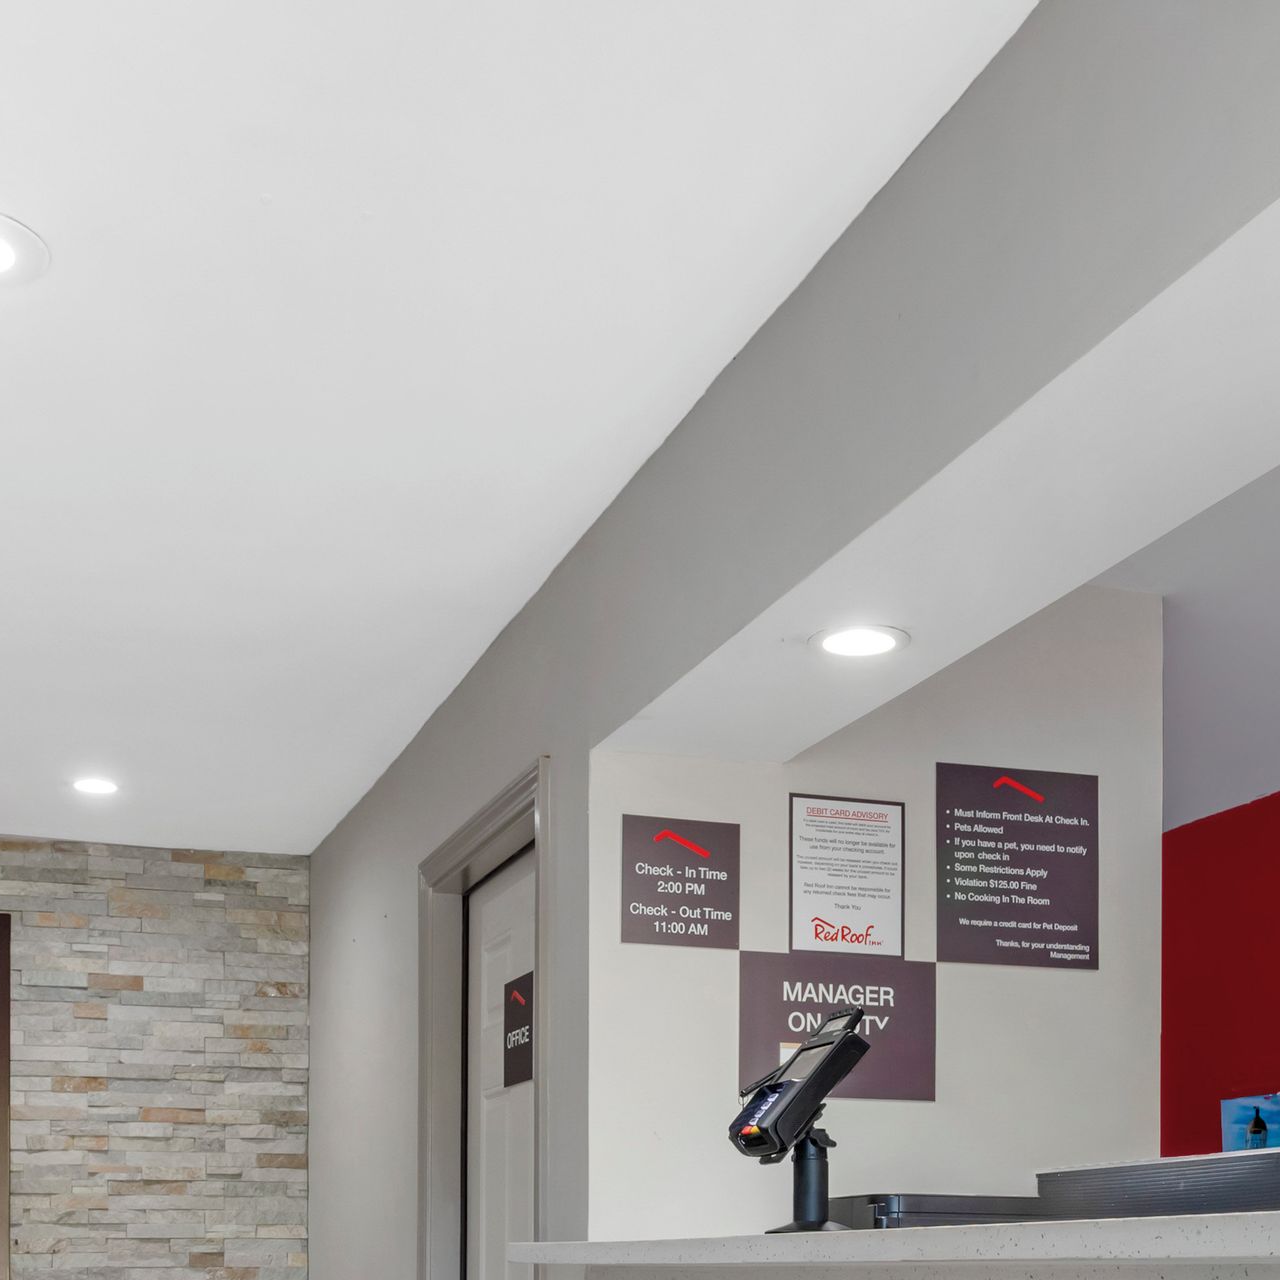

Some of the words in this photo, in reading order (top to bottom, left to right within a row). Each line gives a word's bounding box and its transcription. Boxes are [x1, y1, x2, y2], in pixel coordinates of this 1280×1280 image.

[806, 806, 828, 815] DEBIT
[829, 808, 851, 817] CARD
[851, 810, 889, 820] ADVISORY
[954, 808, 974, 818] Must
[976, 810, 1001, 820] Inform
[1002, 811, 1022, 821] Front
[1024, 813, 1043, 823] Desk
[1044, 815, 1053, 824] At
[1054, 815, 1079, 826] Check
[1080, 818, 1090, 826] In.
[954, 822, 972, 832] Pets
[972, 824, 1004, 834] Allowed
[954, 837, 960, 846] If
[961, 839, 976, 848] you
[977, 839, 996, 848] have
[997, 841, 1003, 849] a
[1004, 841, 1019, 851] pet,
[1020, 843, 1035, 852] you
[1036, 843, 1056, 853] need
[1056, 844, 1065, 853] to
[1066, 845, 1087, 856] notify
[954, 851, 975, 860] upon
[977, 851, 1001, 860] check
[1002, 852, 1010, 861] in
[635, 862, 674, 876] Check
[685, 866, 697, 878] In
[698, 867, 728, 880] Time
[954, 862, 978, 872] Some
[979, 865, 1024, 875] Restrictions
[1025, 868, 1048, 879] Apply
[657, 881, 682, 894] 2:00
[685, 883, 706, 895] PM
[954, 877, 988, 888] Violation
[989, 879, 1019, 890] $125.00
[1020, 882, 1037, 891] Fine
[954, 891, 966, 900] No
[967, 892, 1001, 904] Cooking
[1002, 895, 1010, 903] In
[1011, 895, 1025, 904] The
[1026, 896, 1050, 906] Room
[629, 902, 668, 916] Check
[679, 905, 701, 919] Out
[702, 907, 732, 921] Time
[654, 921, 685, 934] 11:00
[687, 923, 708, 936] AM
[959, 918, 969, 926] We
[970, 919, 993, 928] require
[998, 920, 1017, 928] credit
[1018, 921, 1032, 929] card
[1042, 922, 1053, 930] Pet
[1054, 923, 1078, 932] Deposit
[814, 923, 839, 942] Red
[841, 924, 875, 946] Roof
[995, 939, 1020, 948] Thanks,
[1021, 940, 1030, 948] for
[1031, 942, 1045, 950] your
[1046, 941, 1090, 952] understanding
[1050, 950, 1090, 960] Management
[783, 981, 895, 1007] MANAGER
[788, 1011, 822, 1032] ON
[506, 1025, 530, 1049] OFFICE
